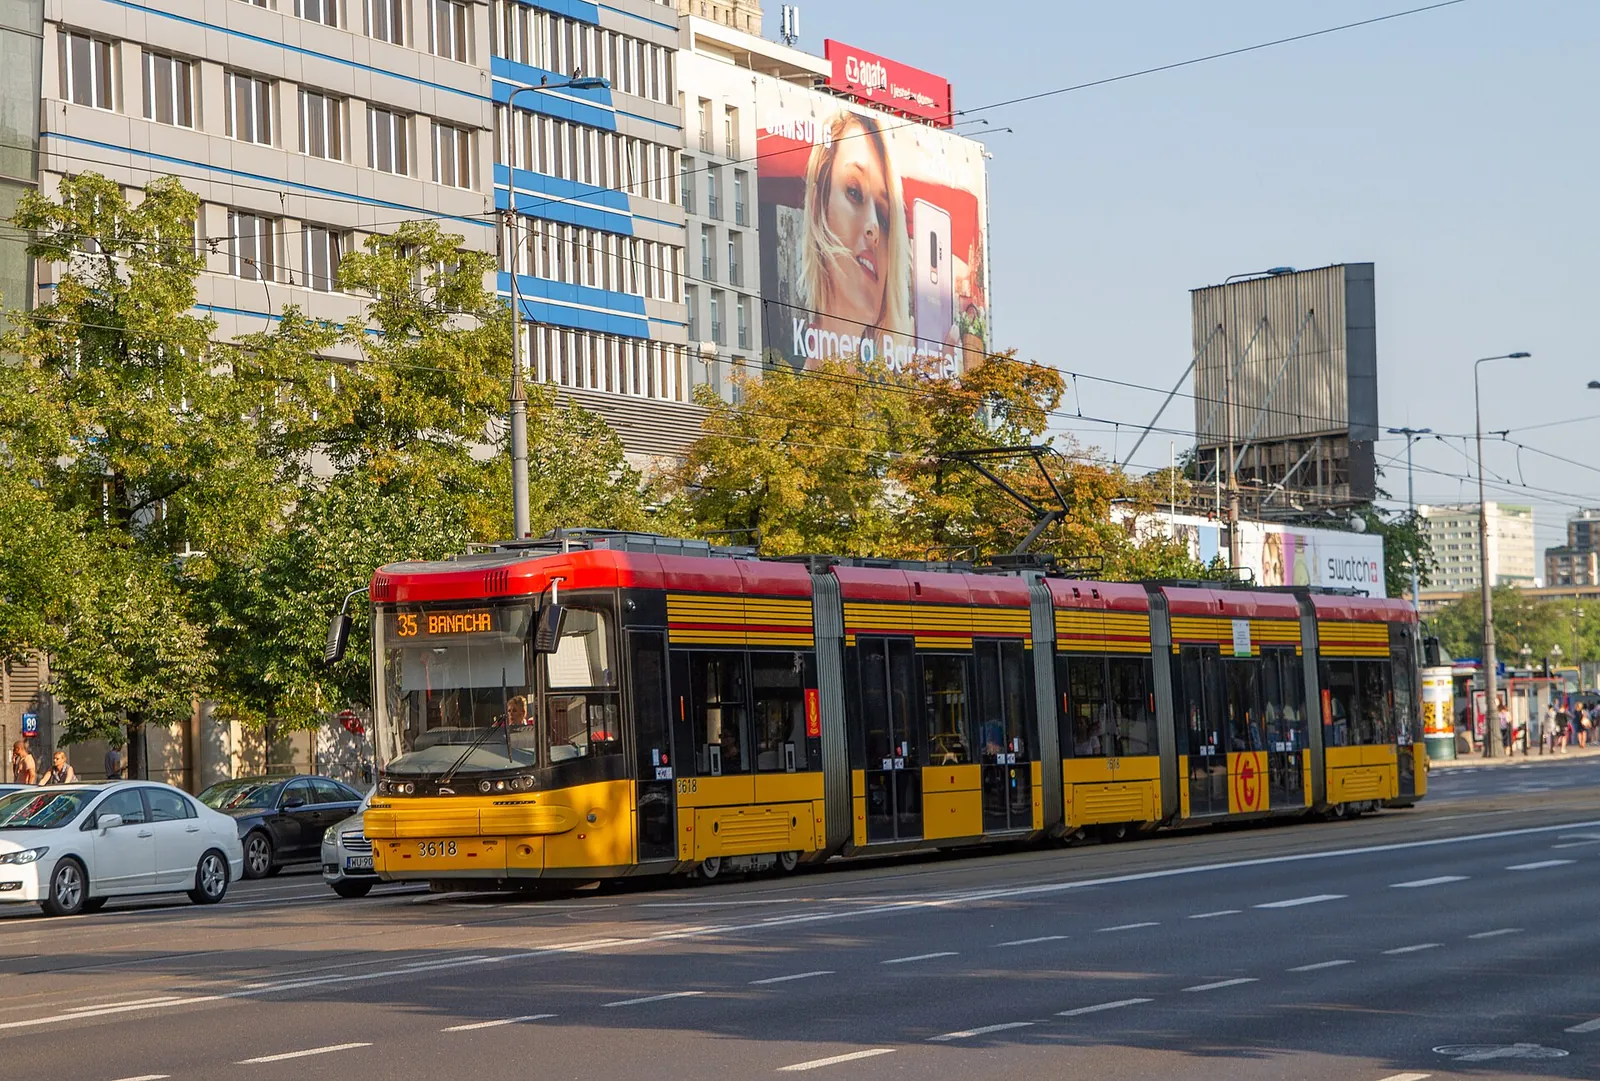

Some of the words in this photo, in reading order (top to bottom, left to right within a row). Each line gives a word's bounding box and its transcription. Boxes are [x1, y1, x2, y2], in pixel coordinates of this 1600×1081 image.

[859, 60, 888, 97] agata
[793, 317, 875, 363] Kamera
[1327, 556, 1370, 582] swatch
[397, 613, 418, 636] 35
[428, 613, 491, 634] BANACHA
[26, 717, 37, 731] 89
[677, 779, 698, 794] 3618
[417, 840, 458, 858] 3618
[351, 857, 362, 867] WU
